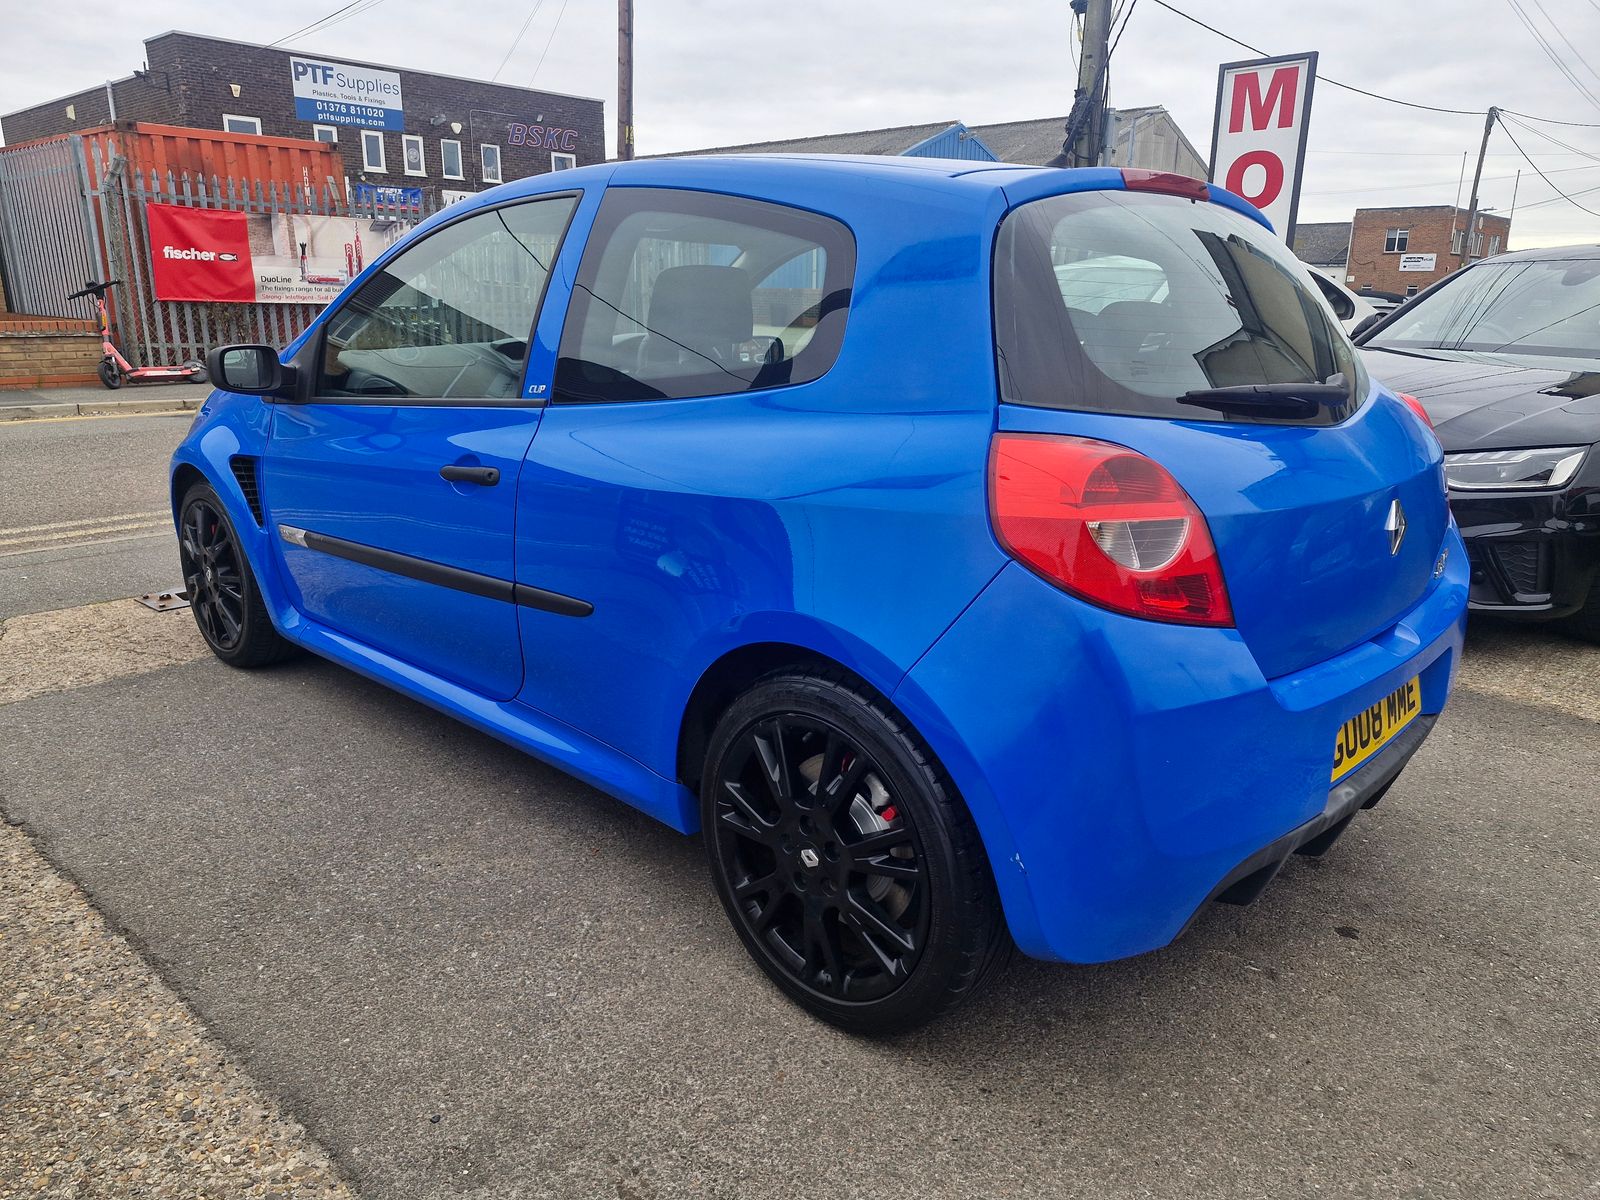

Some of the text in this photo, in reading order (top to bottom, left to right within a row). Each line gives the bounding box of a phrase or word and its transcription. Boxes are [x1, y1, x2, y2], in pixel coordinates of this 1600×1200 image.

[293, 61, 400, 96] PTF Supplies
[312, 89, 339, 99] Plastics,
[341, 93, 357, 101] Tools
[364, 97, 386, 105] Fixings
[316, 101, 384, 118] 01376 811020
[317, 113, 385, 127] ptfsupplies.com
[508, 123, 578, 151] BSKC
[163, 245, 216, 261] fischer
[260, 275, 292, 283] DuoLine
[274, 285, 294, 293] fixings
[528, 384, 546, 394] CUP
[1386, 682, 1416, 730] MME
